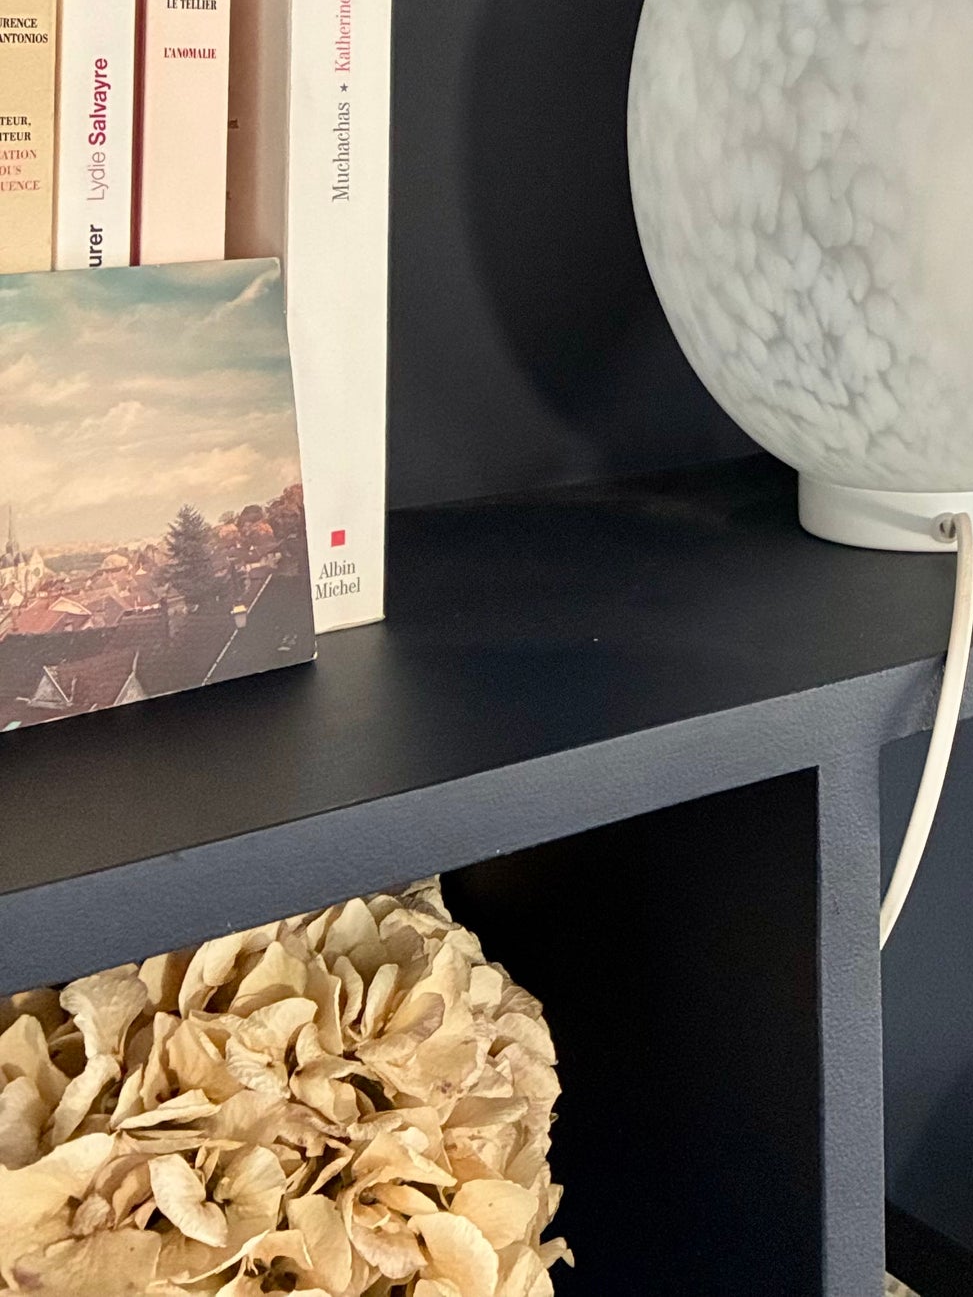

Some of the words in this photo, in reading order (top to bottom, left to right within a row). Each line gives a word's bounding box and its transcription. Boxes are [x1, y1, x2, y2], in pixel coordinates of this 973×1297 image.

[164, 47, 217, 59] L'ANOMALIE
[88, 58, 111, 146] Salvayre
[332, 102, 351, 202] Muchachas
[87, 151, 109, 201] Lydie
[319, 560, 356, 580] Albin
[315, 577, 360, 601] Michel
